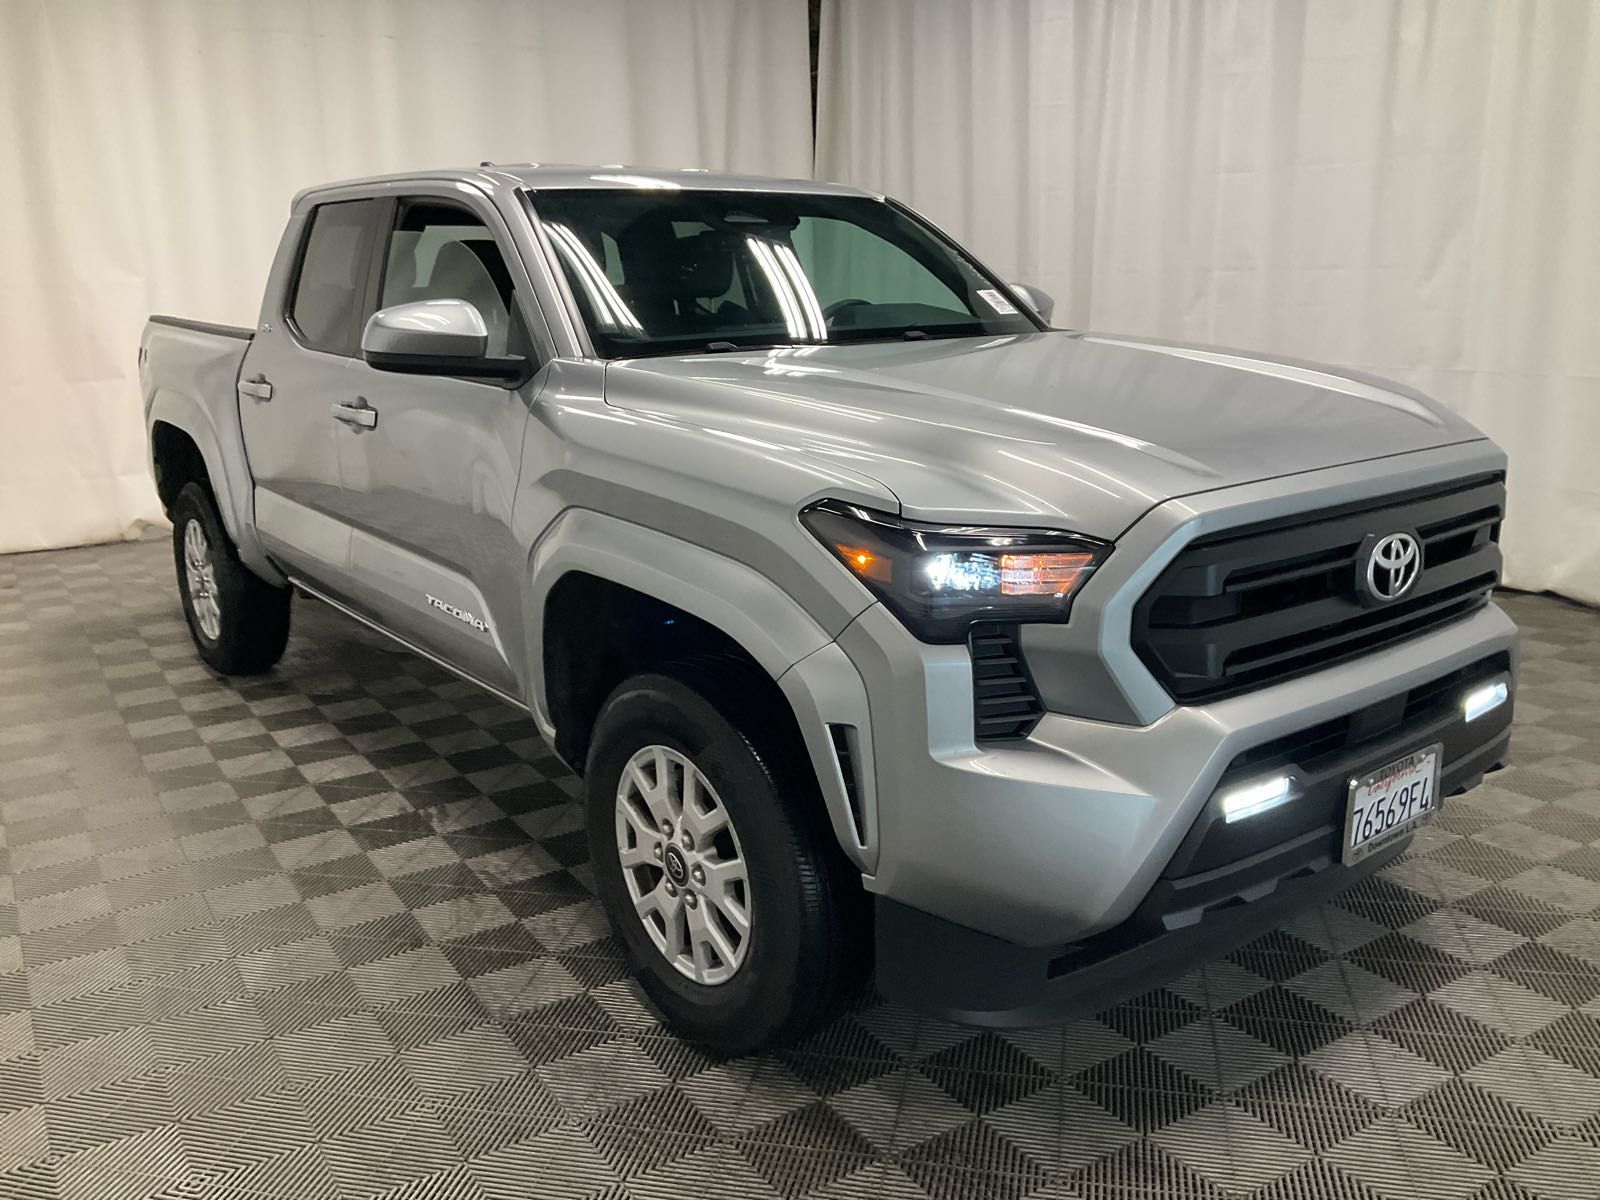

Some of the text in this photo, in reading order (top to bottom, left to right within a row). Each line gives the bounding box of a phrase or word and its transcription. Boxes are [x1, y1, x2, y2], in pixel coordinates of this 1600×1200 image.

[425, 593, 488, 632] TACOMA
[1379, 756, 1415, 780] TOYOTA
[1353, 777, 1429, 845] 76569F4
